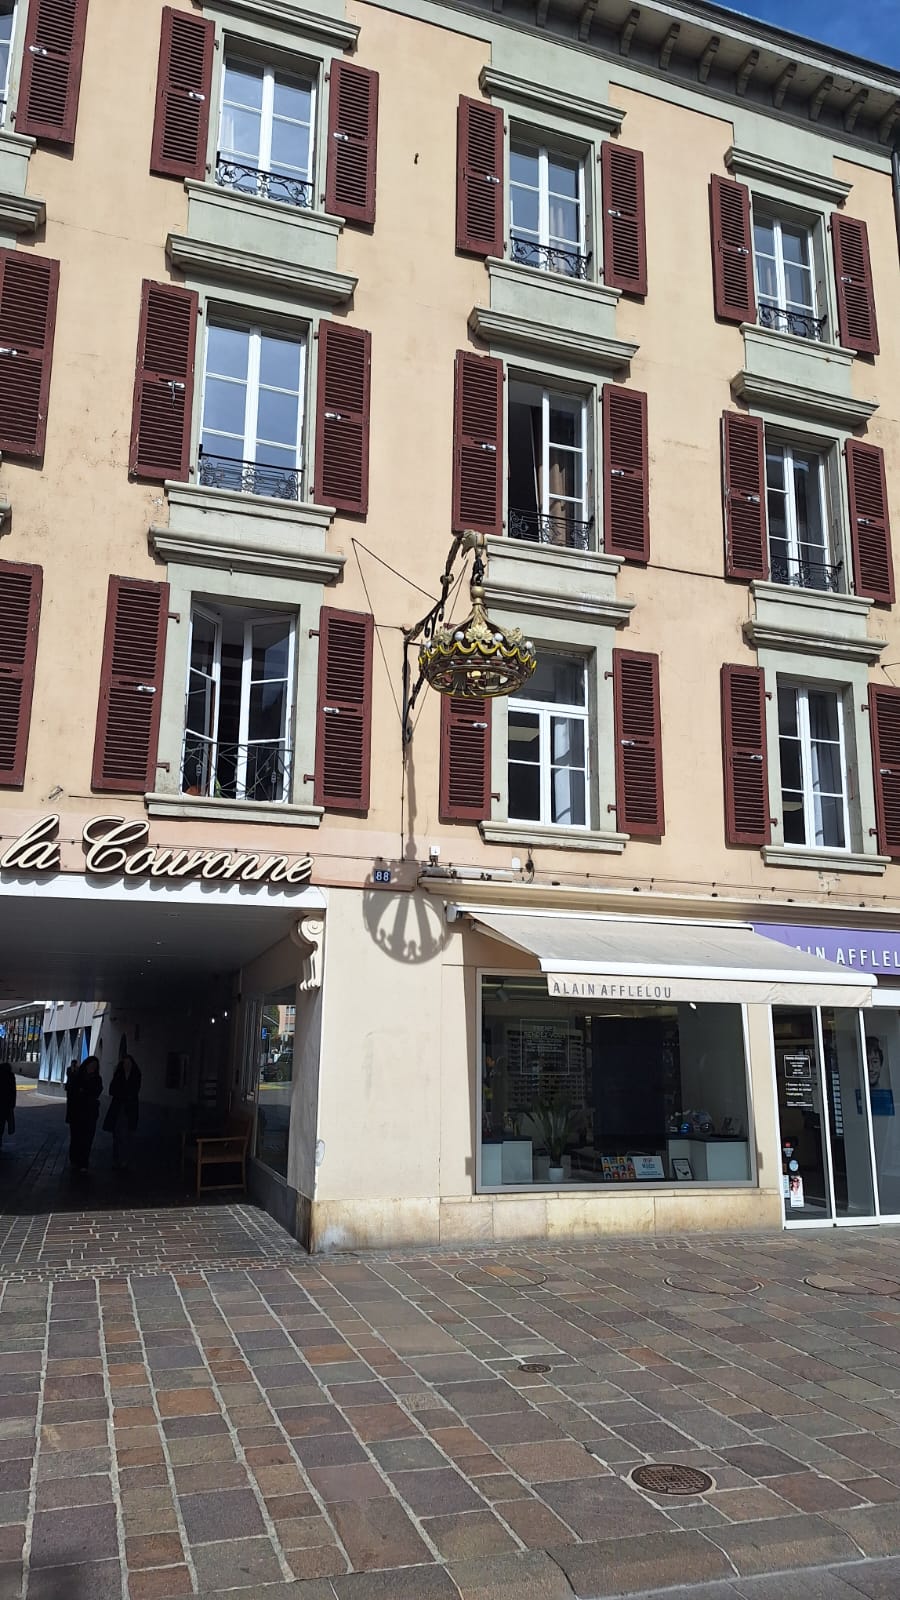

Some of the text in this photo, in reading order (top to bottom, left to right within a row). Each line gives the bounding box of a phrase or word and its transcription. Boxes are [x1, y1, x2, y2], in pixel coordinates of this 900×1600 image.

[0, 814, 315, 883] la Couronne
[376, 871, 390, 881] 88
[553, 982, 671, 998] ALAIN AFFLELOU
